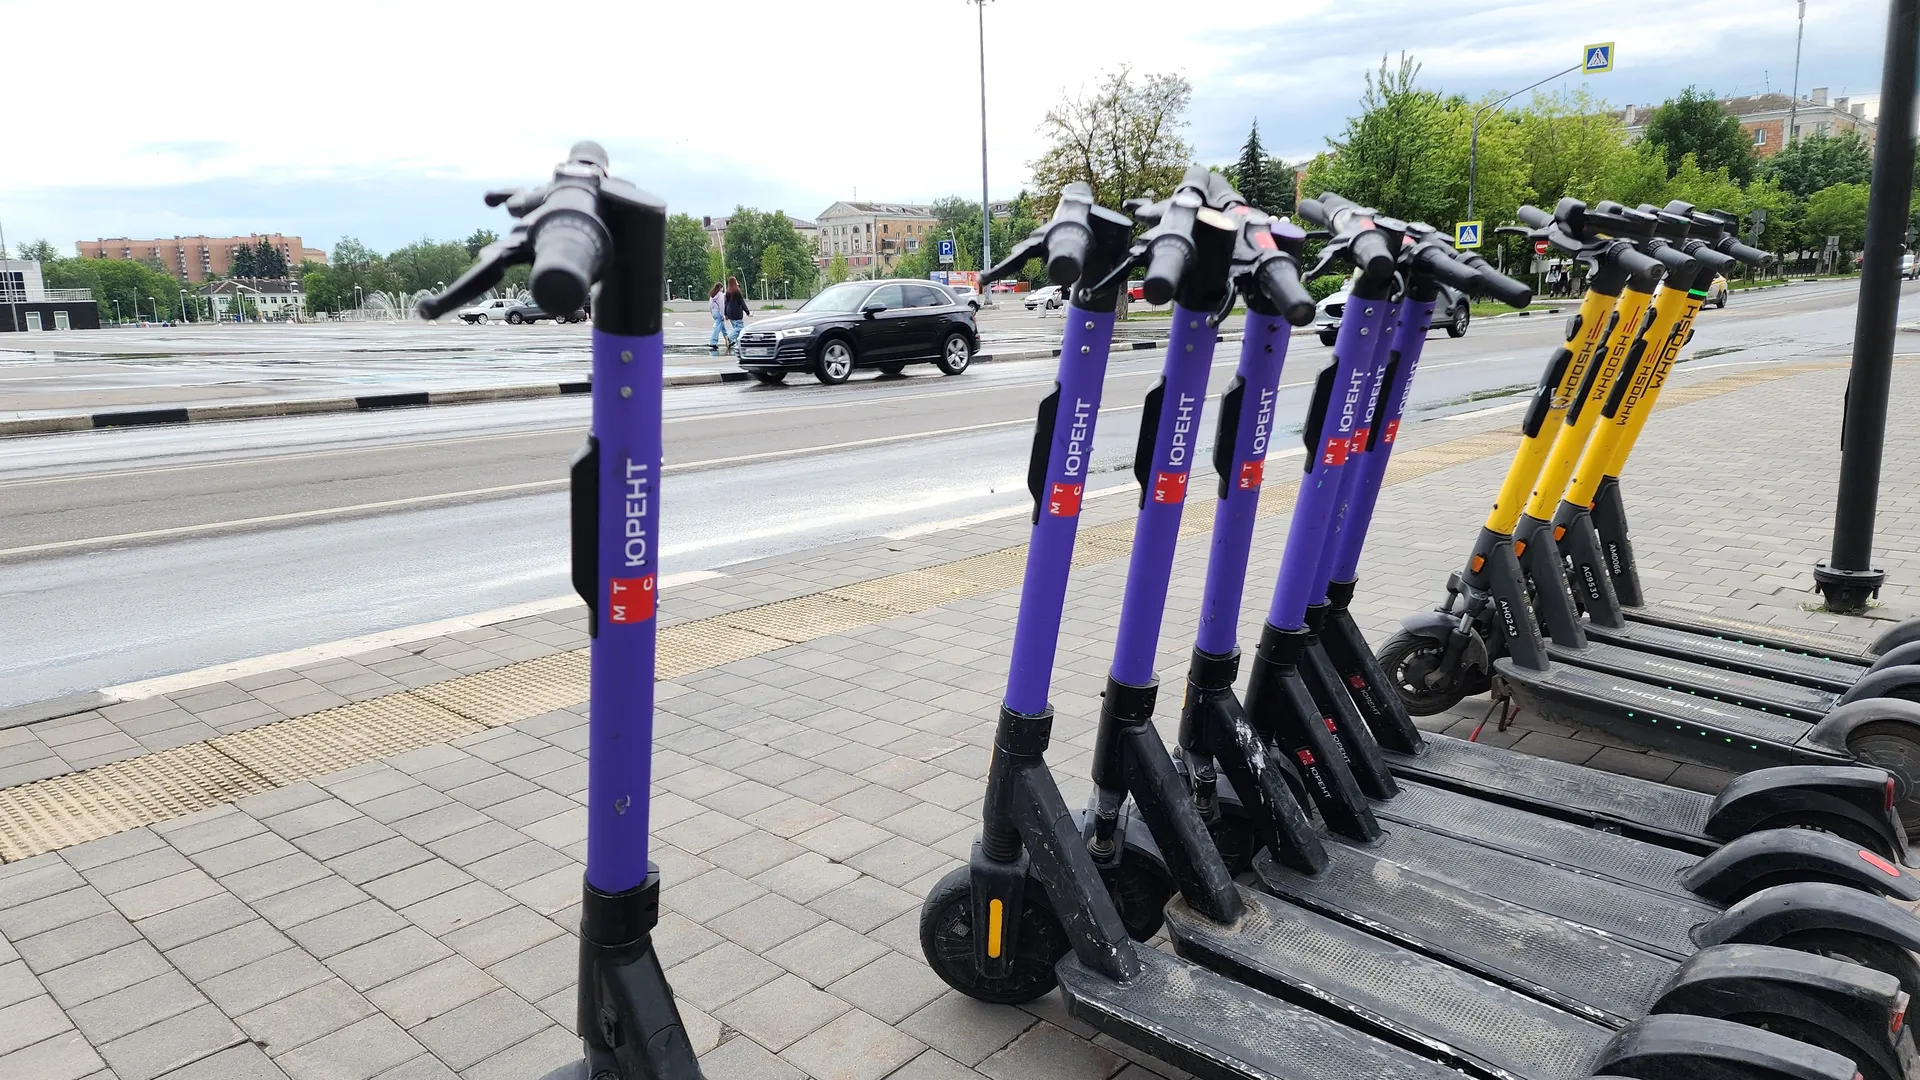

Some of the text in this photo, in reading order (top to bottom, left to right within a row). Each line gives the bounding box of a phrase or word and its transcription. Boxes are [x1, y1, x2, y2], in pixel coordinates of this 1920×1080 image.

[942, 242, 951, 255] P
[1592, 335, 1630, 401] WHOOSH
[1649, 304, 1699, 389] WHOOSH
[1252, 387, 1274, 455] ЮРЕНТ
[1338, 368, 1364, 432] ЮРЕНТ
[1363, 364, 1386, 423] ЮРЕНТ
[1616, 365, 1652, 426] WHOOSH
[1064, 397, 1091, 477] ЮРЕНТ
[1168, 392, 1195, 466] ЮРЕНТ
[625, 458, 648, 567] ЮРЕНТ
[1608, 543, 1622, 575] AM0066
[1500, 600, 1518, 637] AH0243
[1612, 685, 1701, 710] WHOOSH
[1332, 733, 1352, 764] ЮРЕНТ
[1309, 766, 1332, 799] ЮРЕНТ
